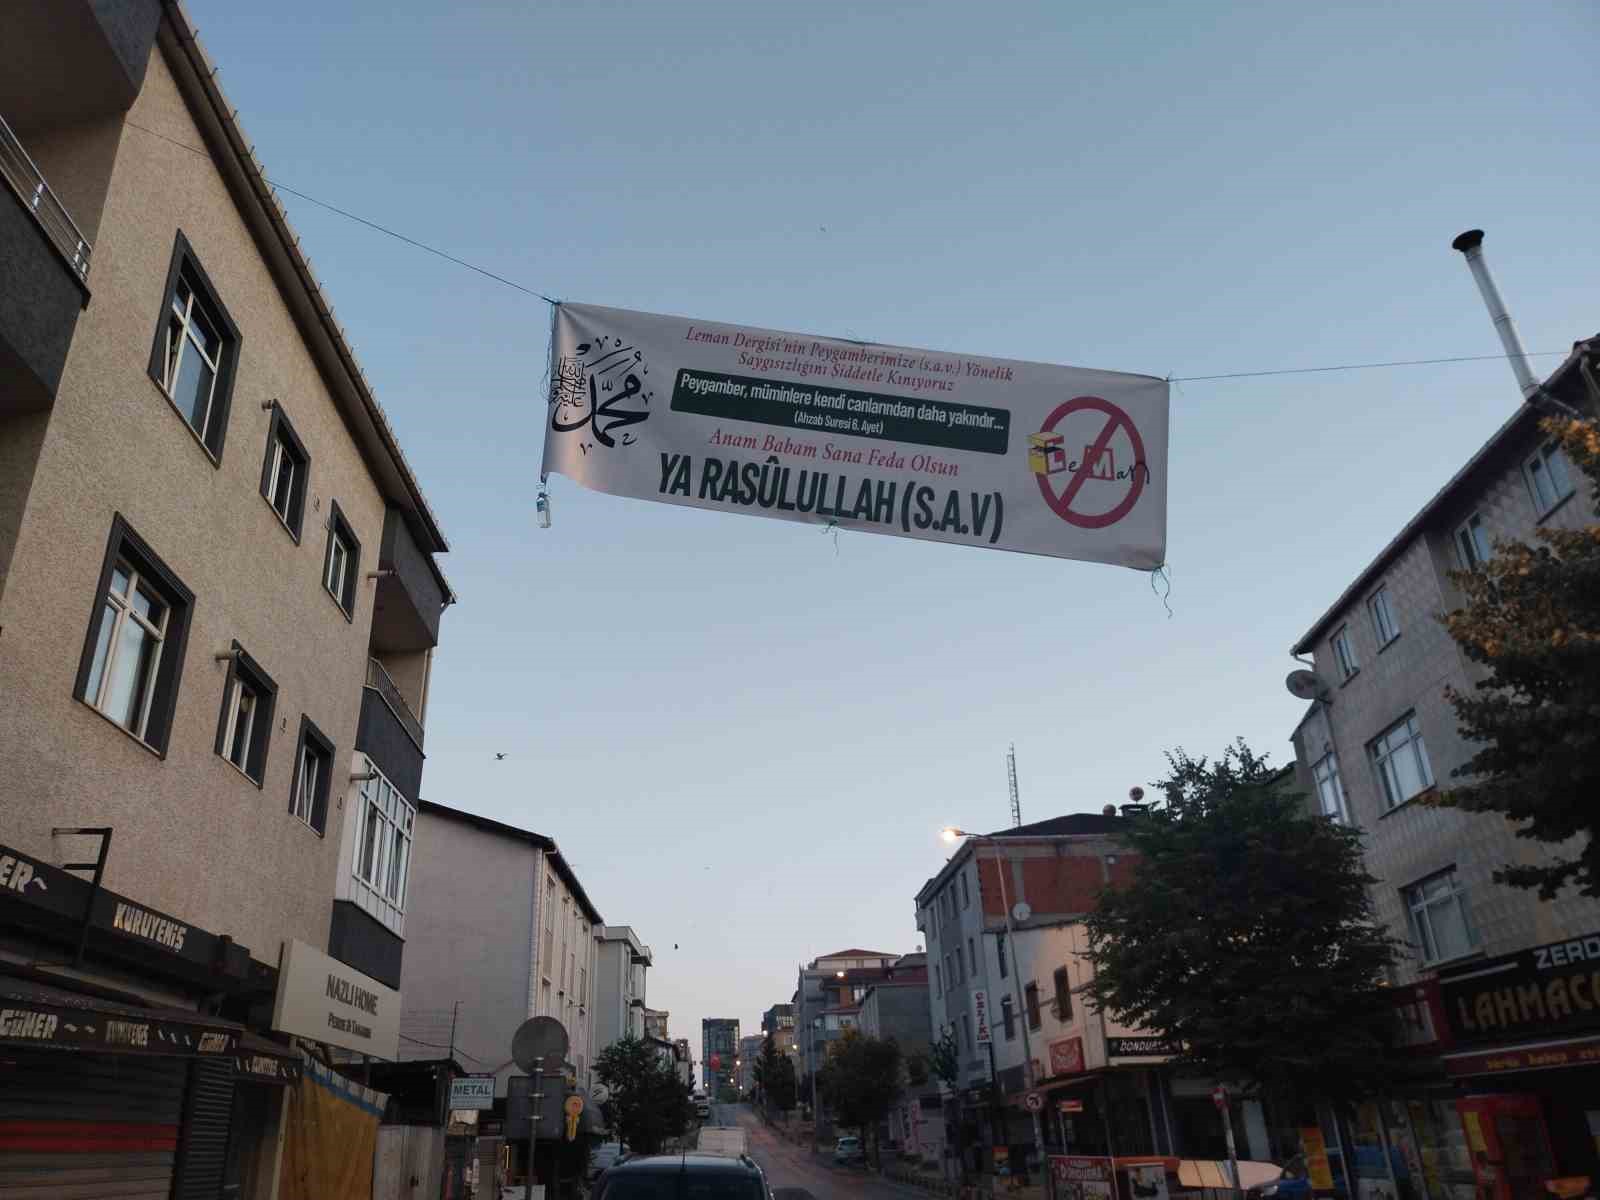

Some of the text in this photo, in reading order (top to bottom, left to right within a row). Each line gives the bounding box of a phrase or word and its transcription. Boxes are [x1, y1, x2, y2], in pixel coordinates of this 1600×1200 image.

[686, 326, 729, 346] Leman
[733, 332, 806, 355] Dergisi'nin
[809, 341, 914, 370] Peygamberimize
[965, 360, 1014, 381] Yönelik
[680, 372, 1004, 431] Peygamber, müminlere kendi canlarından daha yakındır...
[887, 369, 956, 392] Kınıyoruz
[794, 410, 823, 426] (Ahzab
[825, 415, 851, 429] Suresi
[861, 419, 884, 434] Ayet)
[659, 452, 691, 497] YA
[709, 429, 960, 476] Anam Babam Sana Feda Olsun
[454, 1085, 491, 1097] METAL
